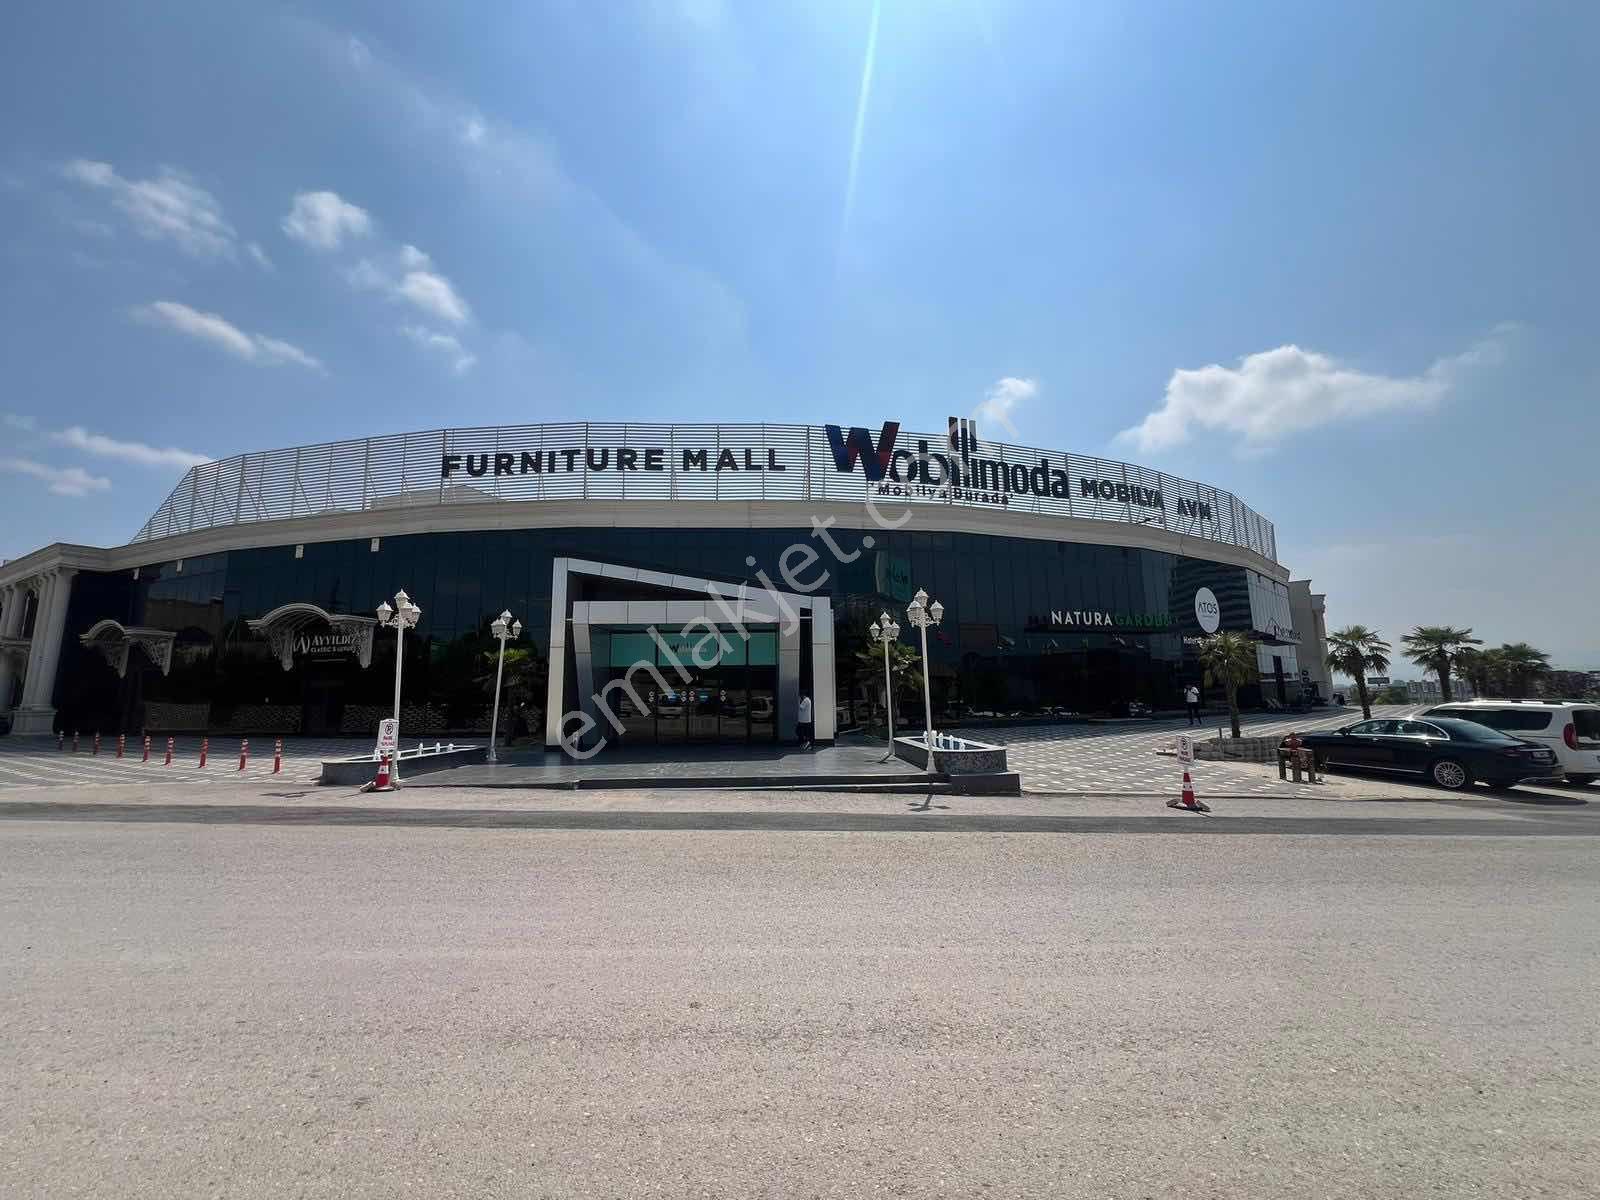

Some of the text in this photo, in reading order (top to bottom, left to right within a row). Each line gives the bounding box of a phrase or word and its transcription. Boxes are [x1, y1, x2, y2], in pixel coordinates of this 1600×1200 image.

[441, 448, 786, 478] FURNITURE MALL
[1080, 477, 1211, 520] MOBILYA AVM
[1051, 611, 1112, 627] NATURA
[1199, 602, 1217, 615] ATOS
